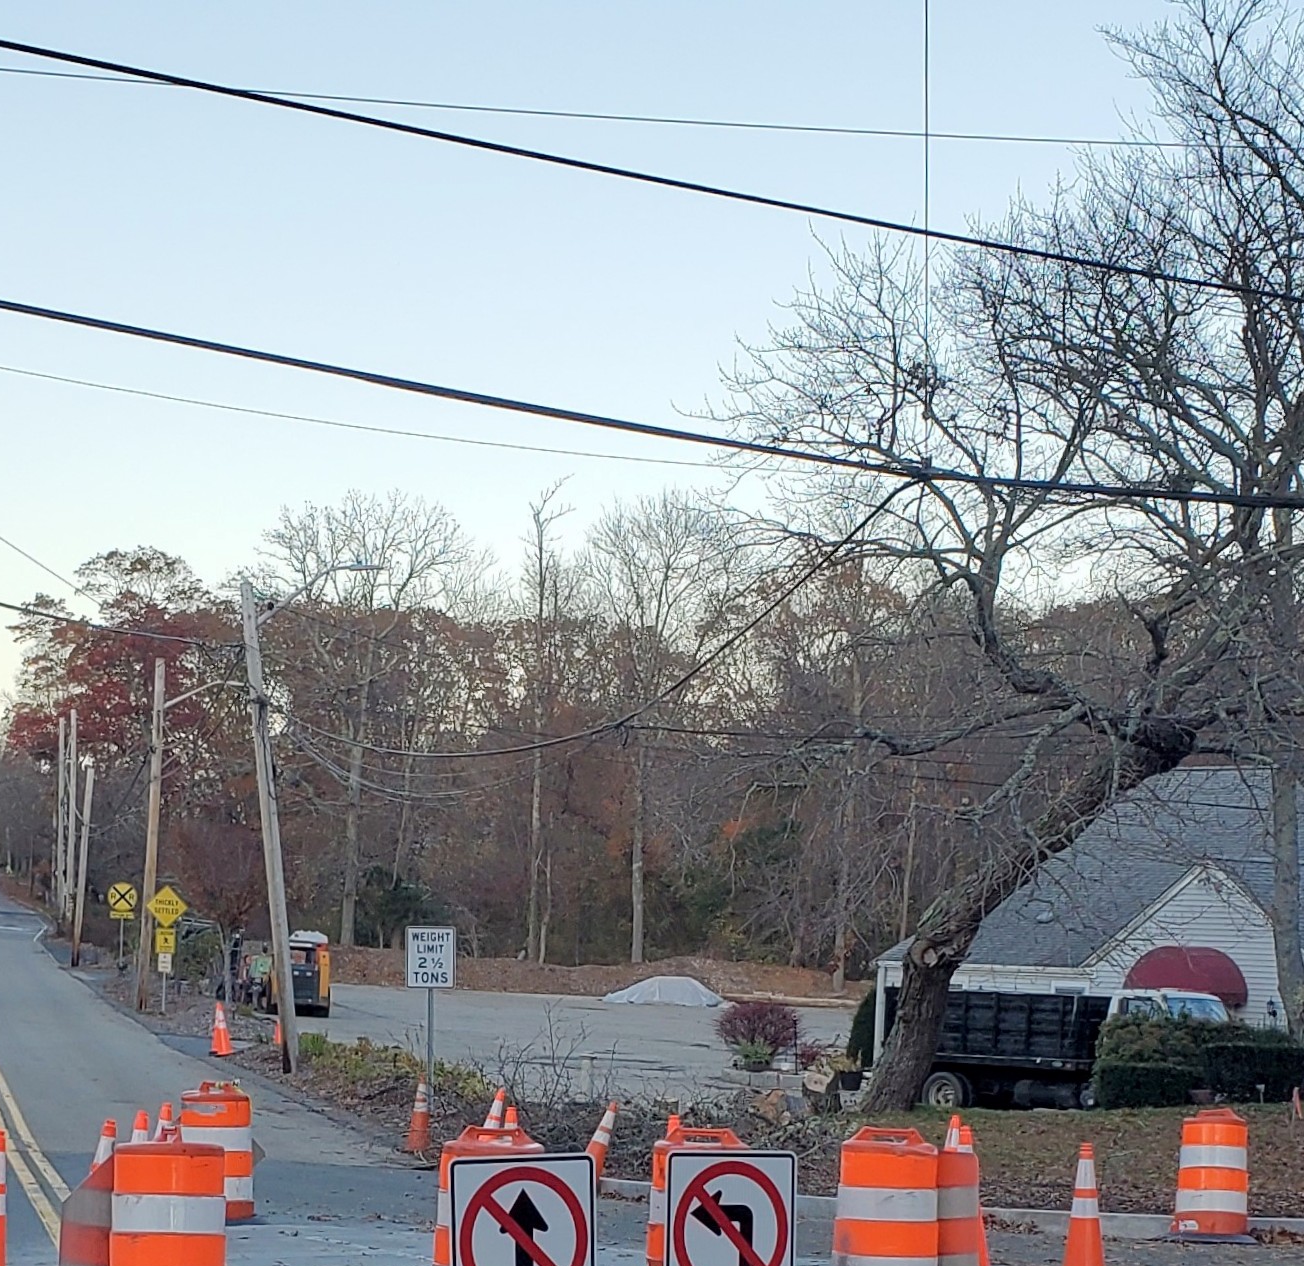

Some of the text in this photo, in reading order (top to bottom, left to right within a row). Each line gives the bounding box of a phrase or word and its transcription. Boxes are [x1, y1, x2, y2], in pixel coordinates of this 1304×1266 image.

[110, 892, 135, 901] R R
[155, 898, 179, 907] THICKLY
[154, 907, 179, 915] SETTLED
[411, 931, 451, 942] WEIGHT
[416, 944, 444, 954] LIMIT
[417, 956, 428, 969] 2
[412, 971, 449, 984] TONS
